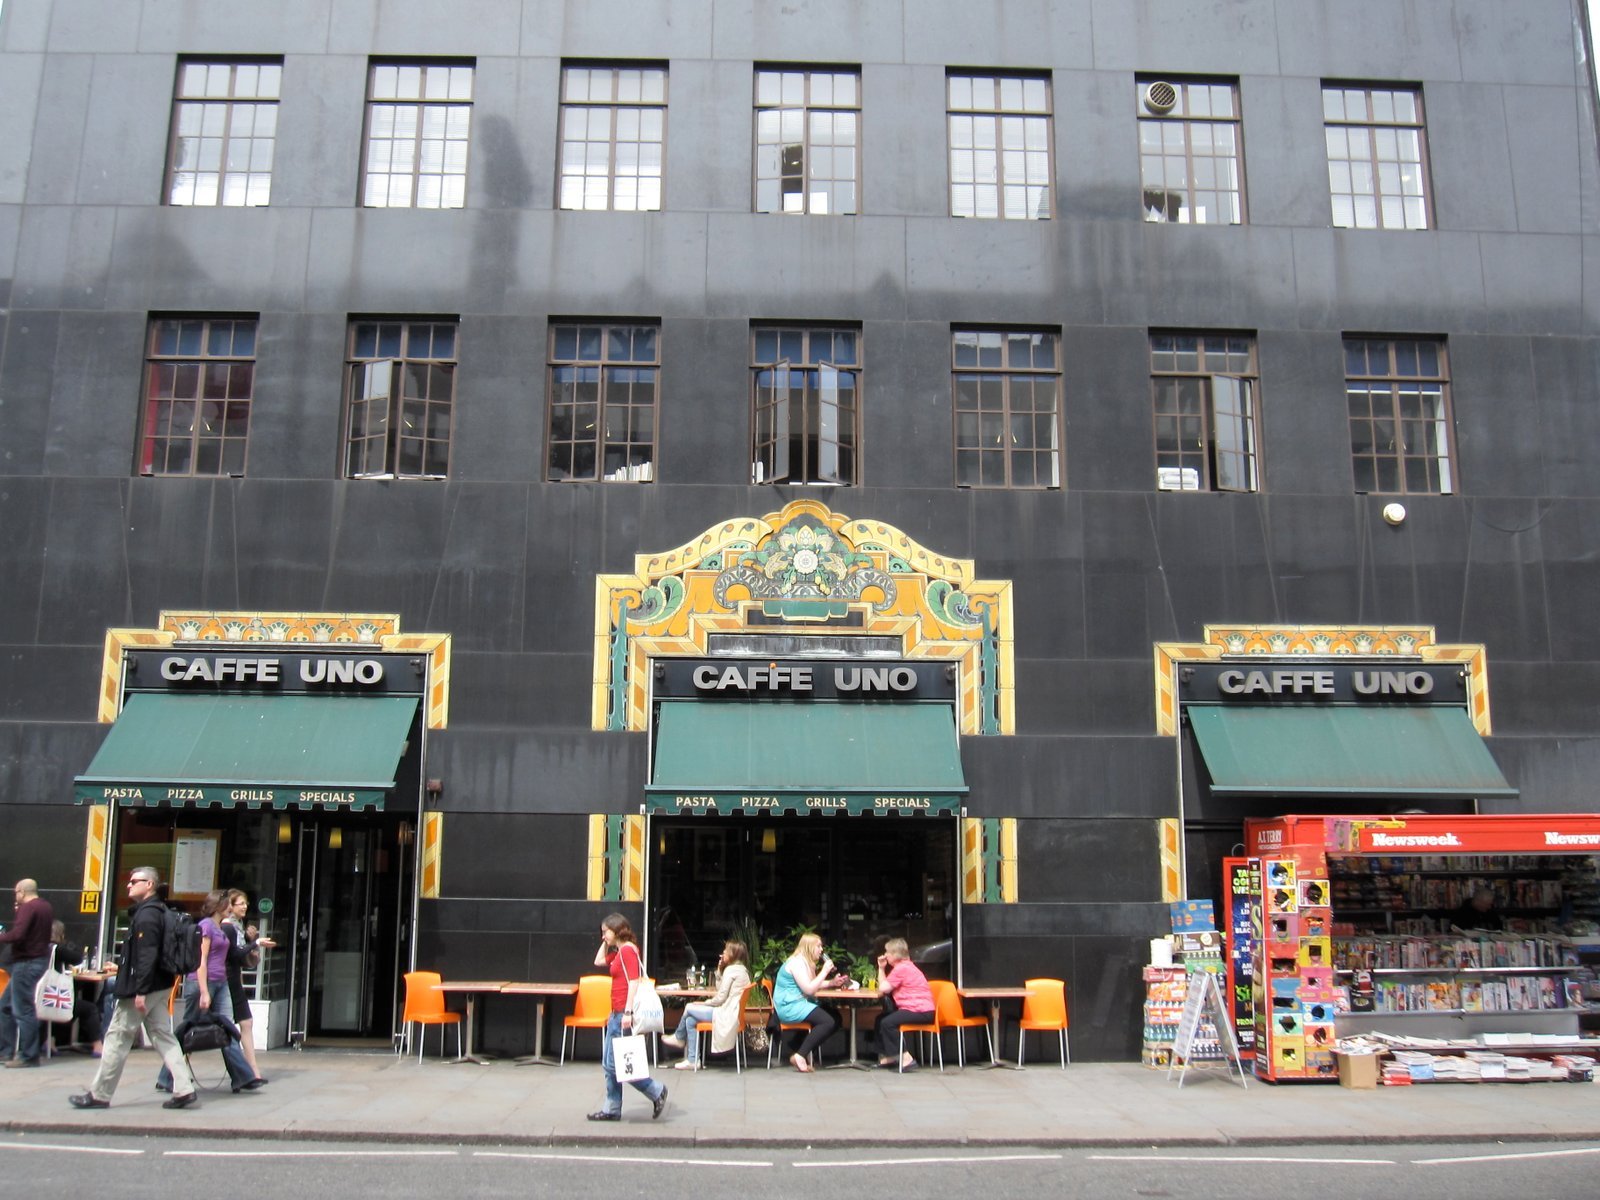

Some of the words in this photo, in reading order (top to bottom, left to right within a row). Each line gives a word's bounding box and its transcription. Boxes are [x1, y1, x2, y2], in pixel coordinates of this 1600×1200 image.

[160, 656, 280, 683] CAFFE
[299, 658, 385, 685] UNO
[692, 665, 813, 691] CAFFE
[833, 667, 918, 692] UNO
[1217, 670, 1336, 694] CAFFE
[1352, 671, 1435, 695] UNO
[103, 788, 143, 799] PASTA
[167, 789, 205, 800] PIZZA
[230, 790, 274, 801] GRILLS
[299, 791, 356, 803] SPECIALS
[675, 796, 717, 808] PASTA
[741, 797, 780, 808] PIZZA
[805, 797, 847, 808] GRILLS
[874, 797, 931, 809] SPECIALS
[1543, 831, 1600, 846] Newsw
[83, 893, 97, 911] H
